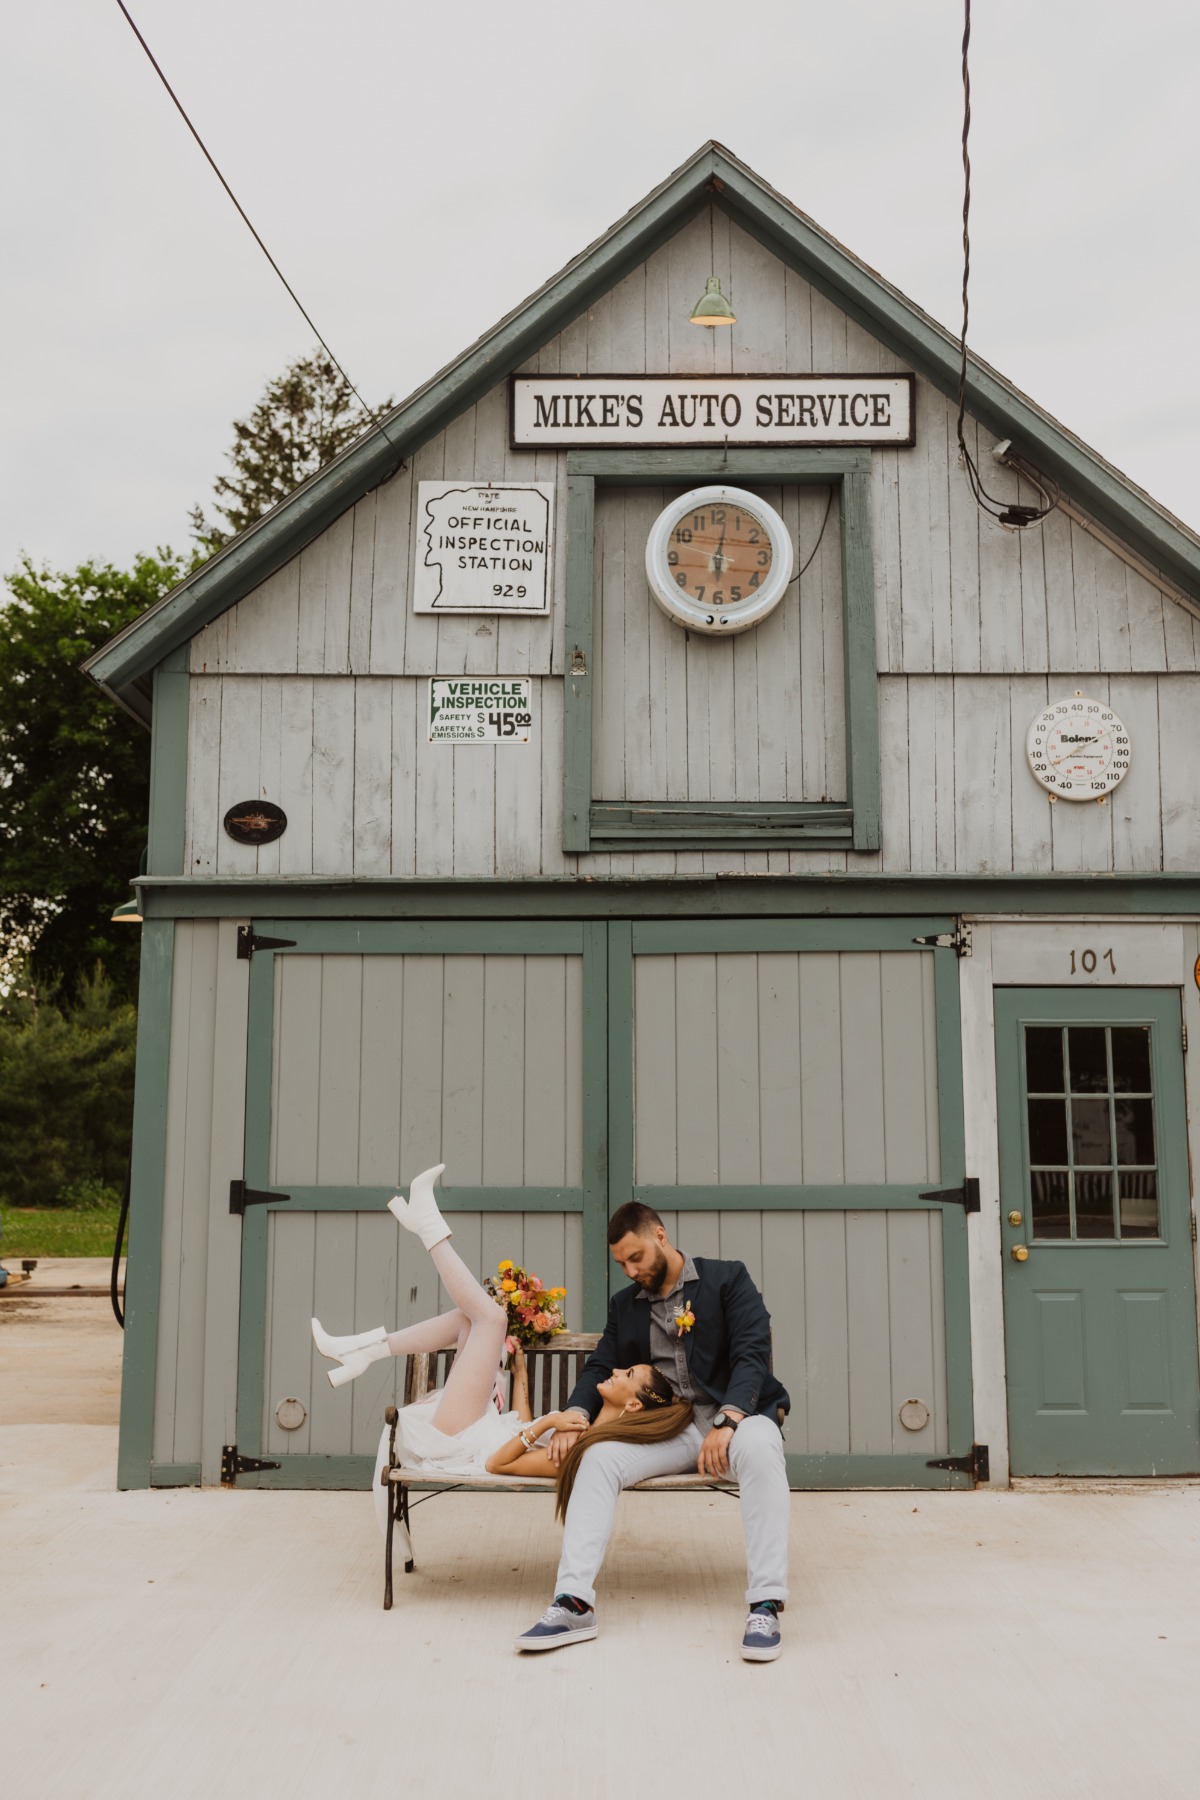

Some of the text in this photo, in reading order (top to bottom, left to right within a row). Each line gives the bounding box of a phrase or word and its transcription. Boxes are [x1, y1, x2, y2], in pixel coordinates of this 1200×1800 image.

[533, 393, 891, 428] MIKE'S AUTO SERVICE
[448, 516, 532, 533] OFFICIAL
[694, 516, 705, 531] 11
[711, 510, 727, 525] 12
[735, 516, 740, 531] 1
[676, 528, 693, 544] 10
[748, 528, 760, 544] 2
[439, 536, 544, 553] INSPECTION
[458, 556, 533, 571] STATION
[667, 551, 679, 566] 9
[757, 551, 769, 566] 3
[676, 572, 687, 588] 8
[748, 571, 760, 588] 4
[493, 584, 527, 598] 929
[695, 586, 706, 601] 7
[712, 591, 723, 605] 6
[730, 586, 741, 602] 5
[448, 683, 522, 695] VEHICLE
[441, 697, 527, 709] INSPECTION
[1056, 706, 1068, 714] 30
[1111, 724, 1122, 732] 70
[1033, 763, 1047, 771] -20
[1113, 761, 1129, 769] 100
[1069, 948, 1117, 975] 101
